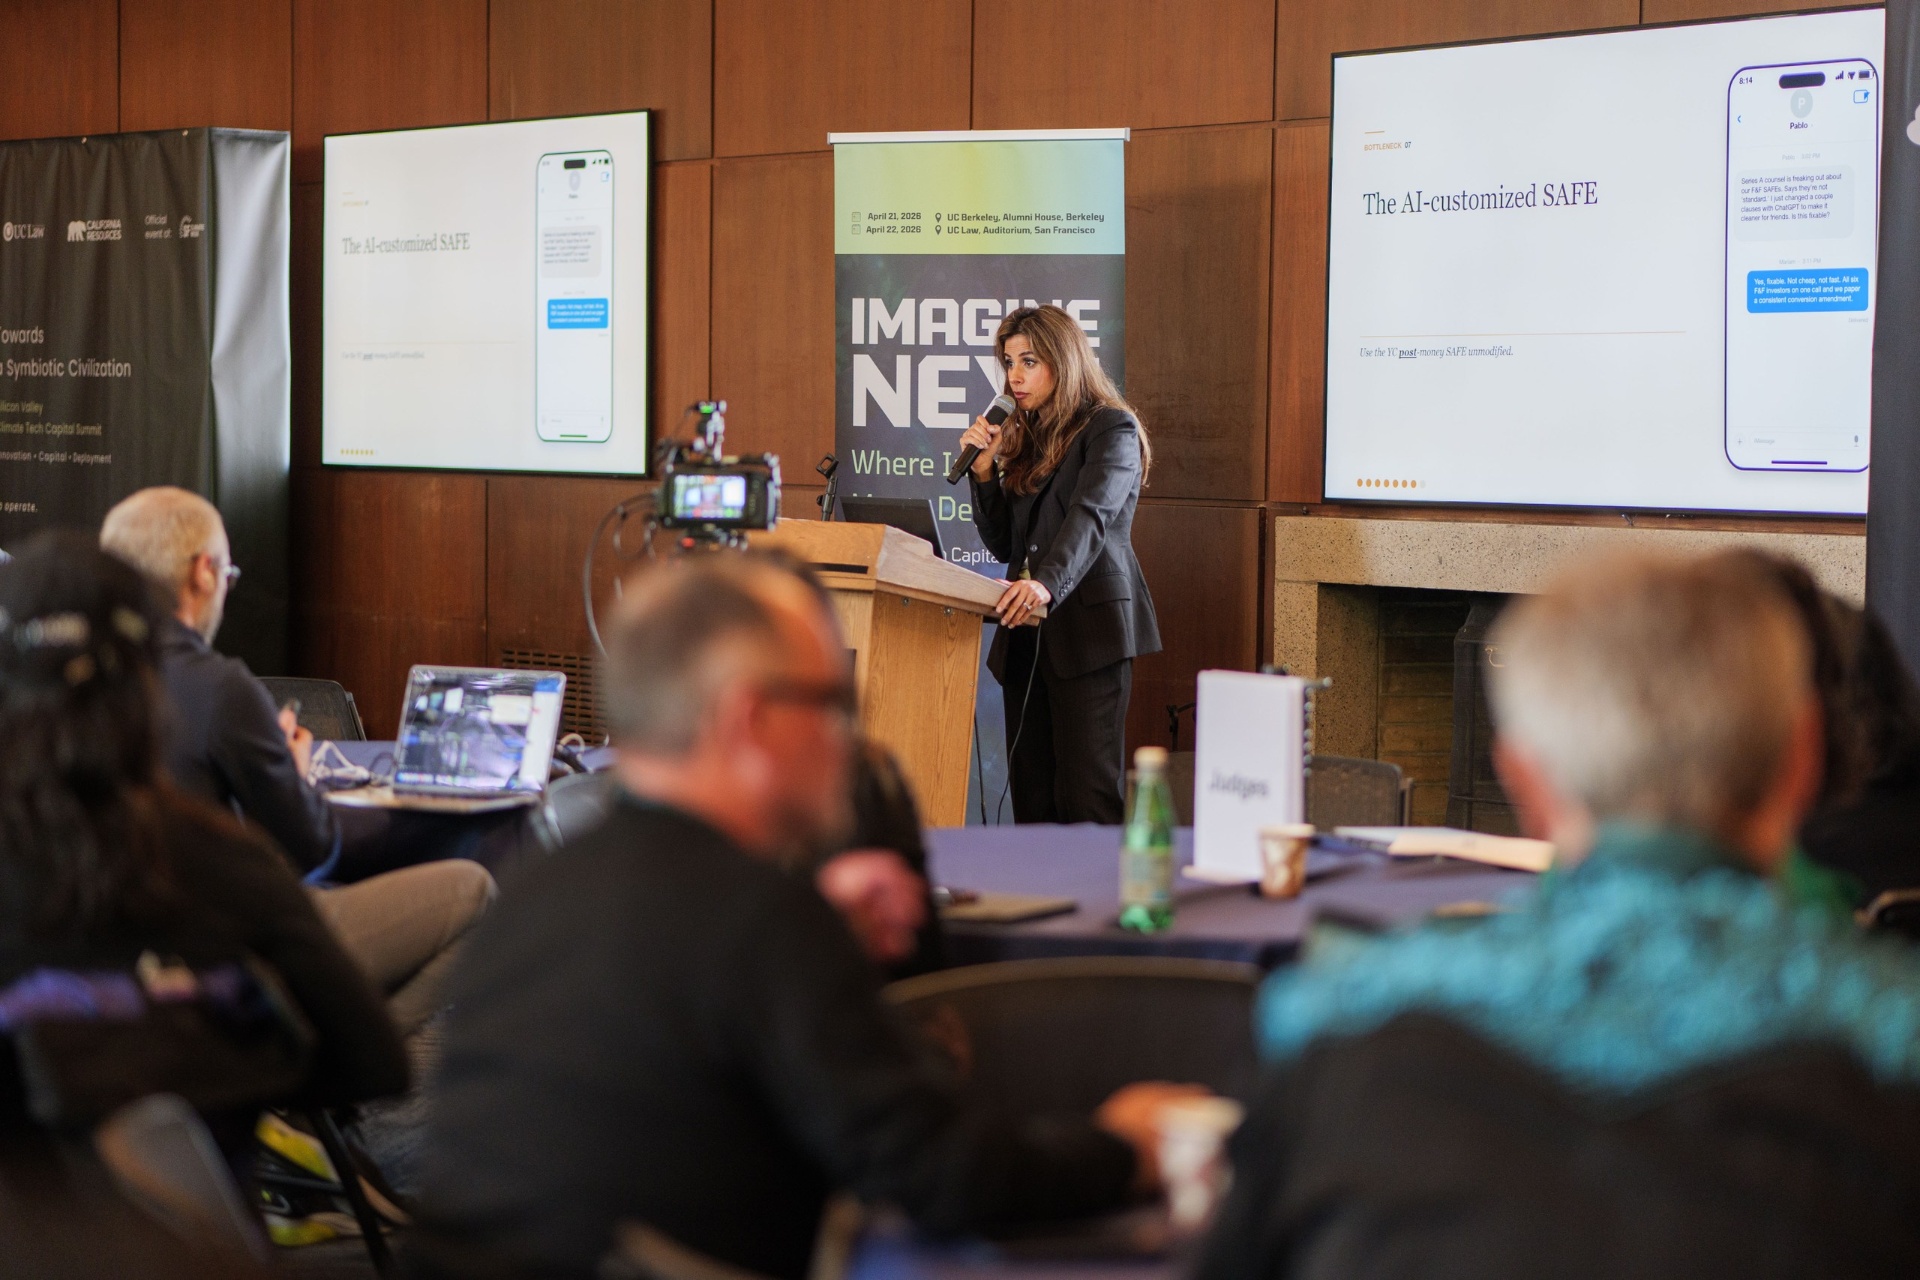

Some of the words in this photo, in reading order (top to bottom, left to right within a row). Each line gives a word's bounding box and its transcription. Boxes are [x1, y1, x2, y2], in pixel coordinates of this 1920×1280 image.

[1789, 122, 1808, 130] Pablo
[1364, 142, 1402, 151] BOTTLENECK
[1404, 141, 1412, 149] 07
[1792, 175, 1814, 183] freaking
[1784, 185, 1798, 193] Says
[1798, 185, 1817, 193] they're
[1363, 191, 1396, 215] The
[1400, 183, 1537, 213] AI-customized
[1542, 181, 1598, 207] SAFE
[1773, 195, 1783, 203] just
[1785, 194, 1808, 202] changed
[1814, 193, 1833, 201] couple
[867, 212, 887, 222] April
[888, 212, 899, 222] 21,
[900, 212, 922, 221] 2026
[947, 213, 960, 221] UC
[961, 213, 1001, 223] Berkeley,
[1002, 213, 1033, 221] Alumni
[1034, 213, 1064, 223] House,
[1065, 213, 1105, 223] Berkeley
[1808, 211, 1830, 219] fixable?
[86, 219, 122, 231] CALIFORNIA
[866, 225, 885, 235] April
[886, 225, 899, 234] 22,
[900, 225, 922, 233] 2026
[947, 226, 960, 234] UC
[961, 226, 981, 235] Law,
[983, 226, 1033, 235] Auditorium,
[1034, 226, 1051, 234] San
[1053, 226, 1096, 234] Francisco
[14, 223, 27, 239] UC
[27, 223, 45, 239] Law
[86, 230, 122, 241] RESOURCES
[342, 236, 361, 255] The
[363, 233, 437, 254] AI-customized
[440, 232, 471, 251] SAFE
[1754, 278, 1766, 286] Yes,
[1766, 277, 1786, 285] fixable.
[1798, 277, 1817, 285] cheap,
[1844, 286, 1860, 294] paper
[1758, 296, 1787, 304] consistent
[1818, 295, 1853, 303] amendment.
[851, 297, 1101, 348] IMAGE
[0, 326, 44, 344] owards
[1359, 347, 1373, 357] Use
[1374, 347, 1386, 357] the
[1387, 347, 1398, 357] YC
[1398, 347, 1445, 359] post-money
[1445, 346, 1467, 357] SAFE
[1468, 346, 1514, 358] unmodified.
[7, 358, 65, 381] Symbiotic
[68, 358, 131, 377] Civilization
[21, 400, 44, 417] Valley
[0, 421, 24, 435] limate
[25, 421, 44, 435] Tech
[45, 422, 76, 438] Capital
[76, 423, 102, 437] Summit
[38, 450, 67, 464] Capital
[73, 452, 112, 466] Deployment
[851, 449, 935, 477] Where
[4, 501, 38, 514] operate.
[951, 547, 999, 566] Capita
